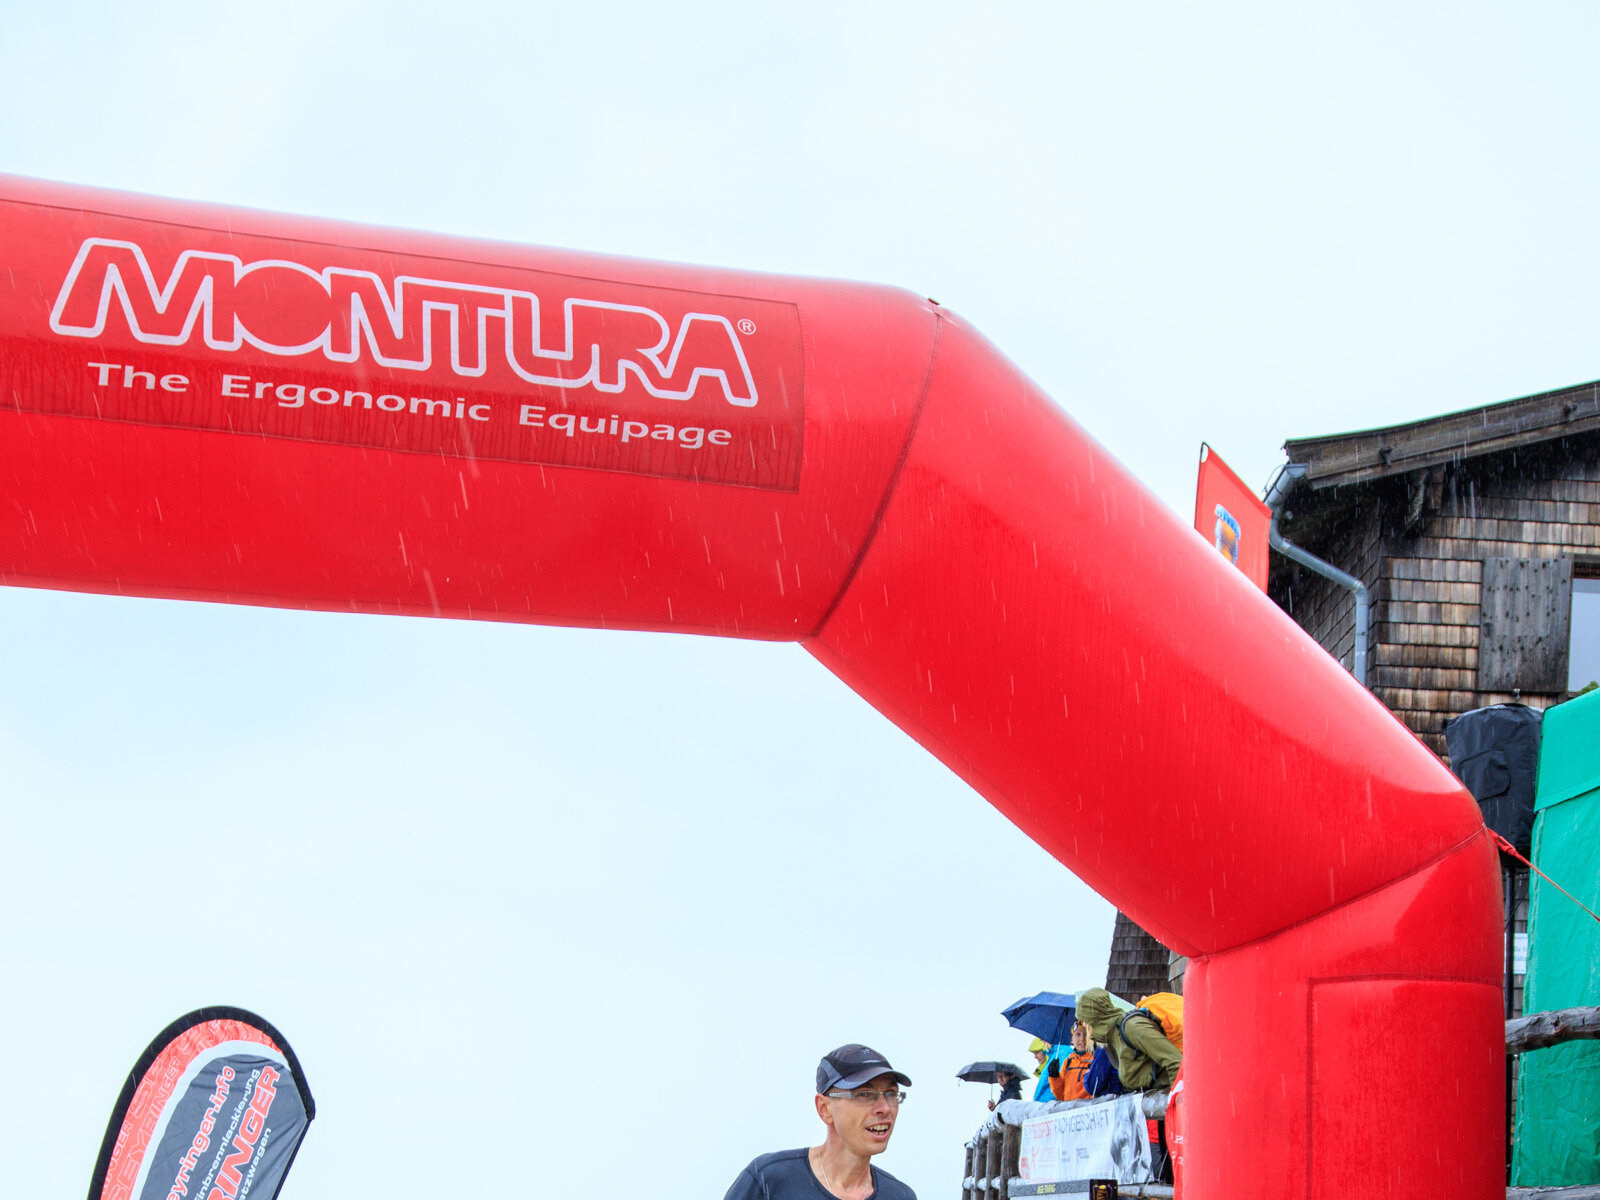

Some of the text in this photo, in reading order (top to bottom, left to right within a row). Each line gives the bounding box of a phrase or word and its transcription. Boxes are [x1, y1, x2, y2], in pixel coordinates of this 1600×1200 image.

[87, 361, 733, 450] The Ergonomic Equipage
